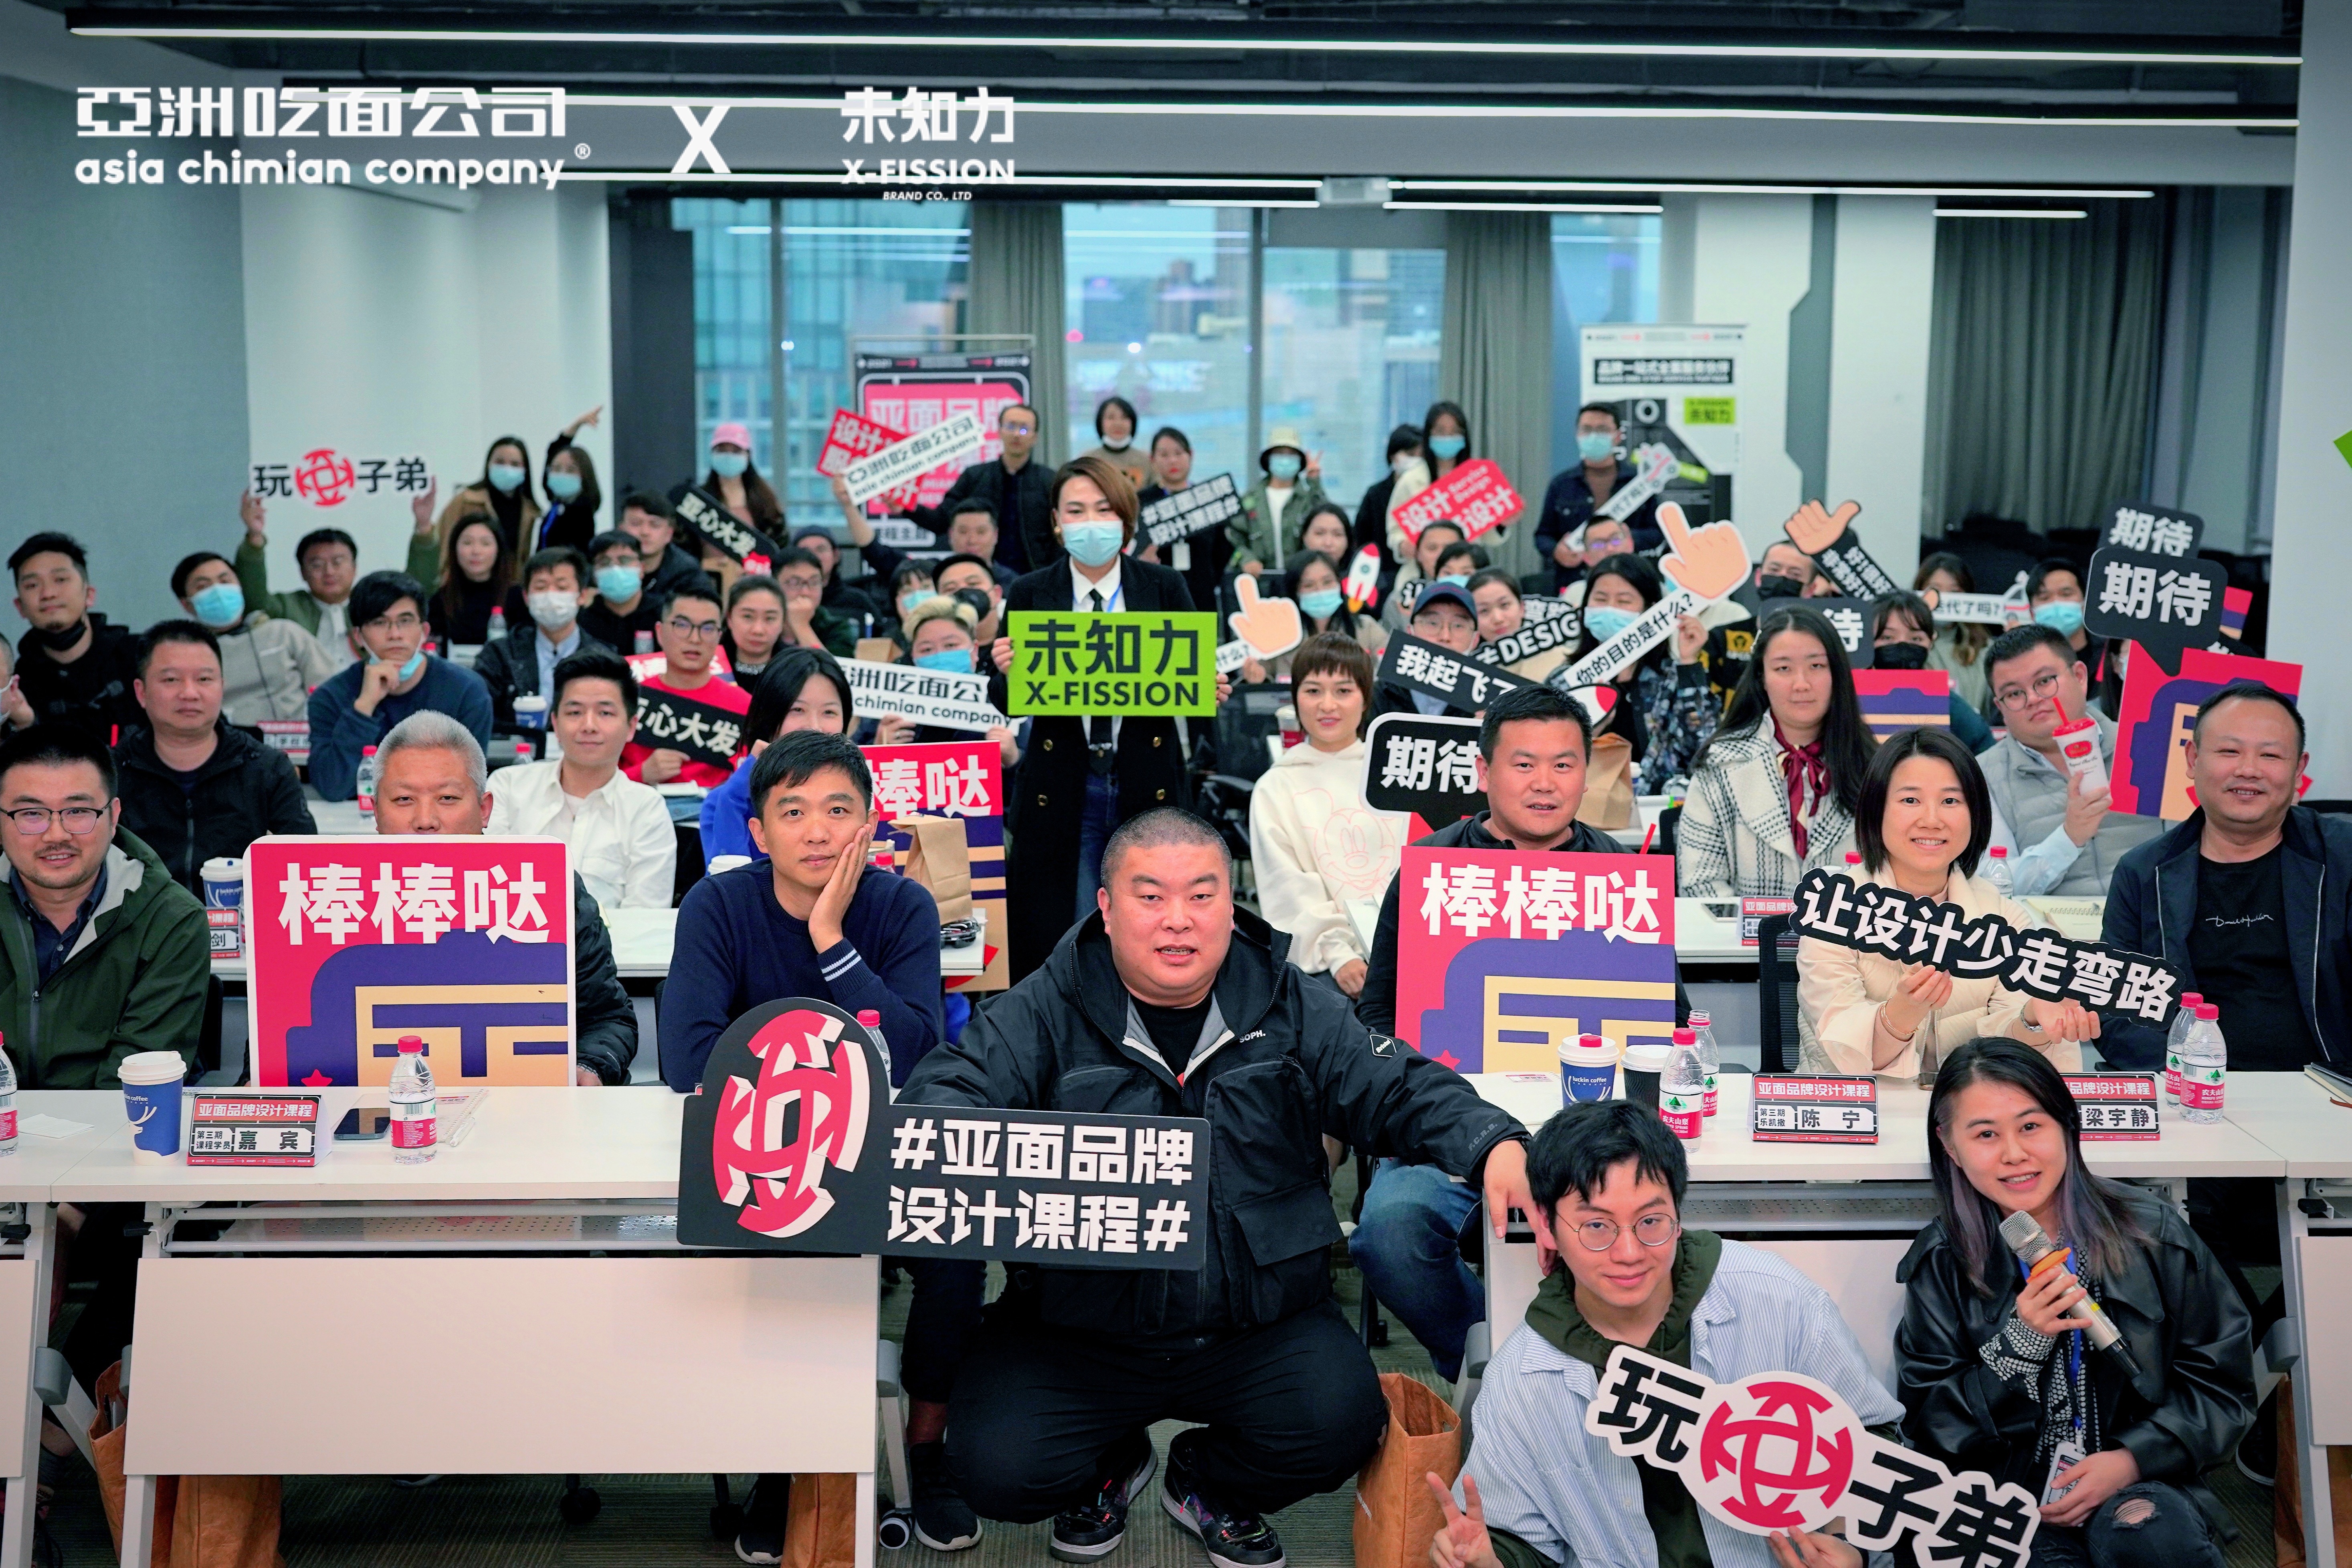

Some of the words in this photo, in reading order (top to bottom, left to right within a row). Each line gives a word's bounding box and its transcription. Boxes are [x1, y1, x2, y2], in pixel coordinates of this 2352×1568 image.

[2108, 507, 2194, 557] 期待
[2098, 562, 2212, 626] 期待
[1024, 619, 1199, 676] 未知力
[841, 664, 990, 703] 洲吃面公
[1024, 681, 1199, 706] X-FISSION
[855, 695, 925, 715] chimian
[932, 706, 1011, 728] company
[1380, 735, 1480, 794] 期待
[278, 862, 550, 945] 棒棒哒
[1420, 862, 1661, 944] 棒棒哒
[1799, 877, 2178, 1022] 让设计少走弯路
[1239, 1029, 1266, 1043] SOPH.
[1758, 1082, 1870, 1097] 亚面品牌设计课程
[2065, 1081, 2150, 1095] 品牌设计课程
[198, 1103, 313, 1117] 亚面品牌设计课程
[1662, 1115, 1689, 1125] 农夫山泉
[1760, 1108, 1785, 1117] 第三期
[2085, 1108, 2149, 1127] 梁宇静
[196, 1140, 230, 1150] 课程学员
[197, 1130, 223, 1139] 第三期
[890, 1117, 1194, 1186] #亚面品牌
[887, 1184, 1191, 1253] 设计课程#
